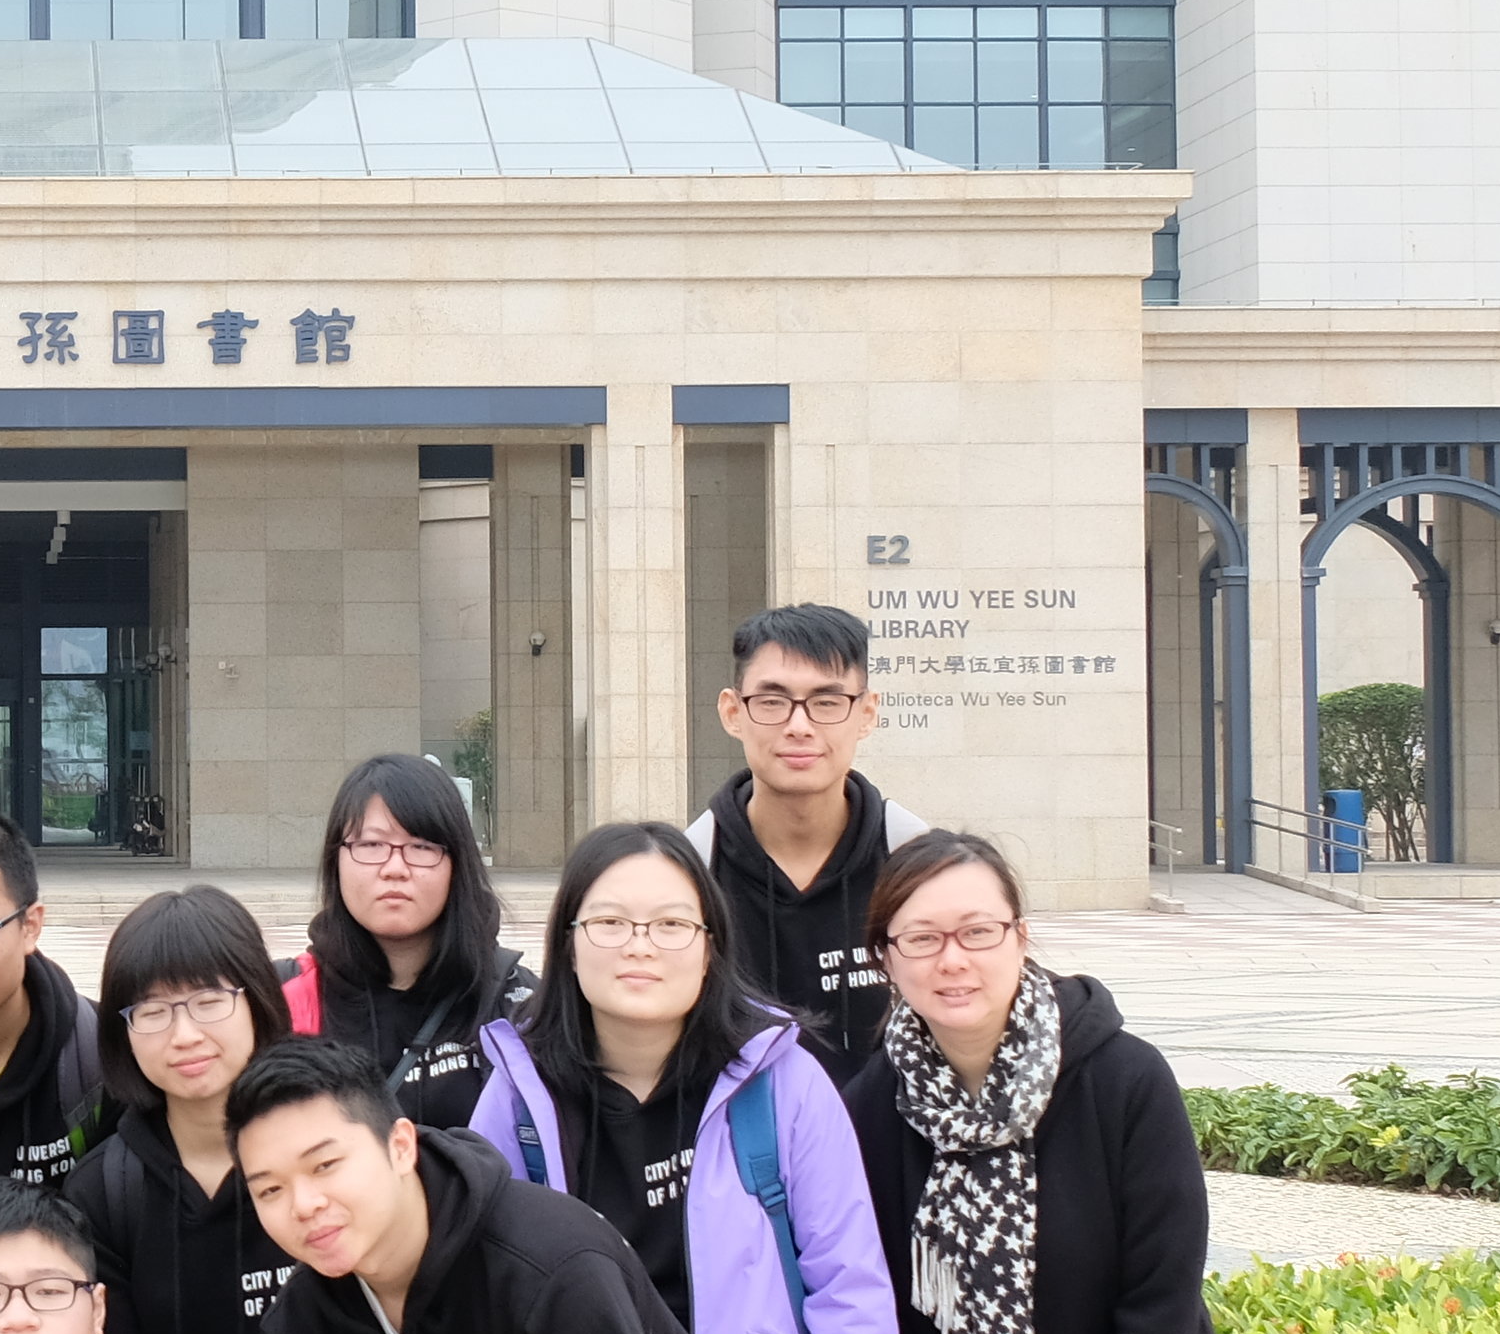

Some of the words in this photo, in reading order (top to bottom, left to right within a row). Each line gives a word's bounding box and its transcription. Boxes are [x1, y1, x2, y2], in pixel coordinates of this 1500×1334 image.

[866, 535, 910, 565] E2
[868, 590, 907, 609] UM
[917, 590, 960, 609] WU
[969, 590, 1015, 609] YEE
[1023, 590, 1077, 609] SUN
[867, 620, 970, 639] LIBRARY
[868, 655, 1117, 675] 澳門大學伍宜孫圖書館
[877, 691, 954, 707] iblioteca
[960, 691, 990, 707] Wu
[997, 691, 1026, 707] Yee
[1033, 691, 1067, 707] Sun
[899, 714, 928, 728] UM
[821, 973, 840, 992] OF
[429, 1054, 468, 1077] HONG
[645, 1160, 670, 1182] CITY
[647, 1187, 665, 1207] OF
[241, 1269, 273, 1292] CITY
[244, 1297, 264, 1317] OF
